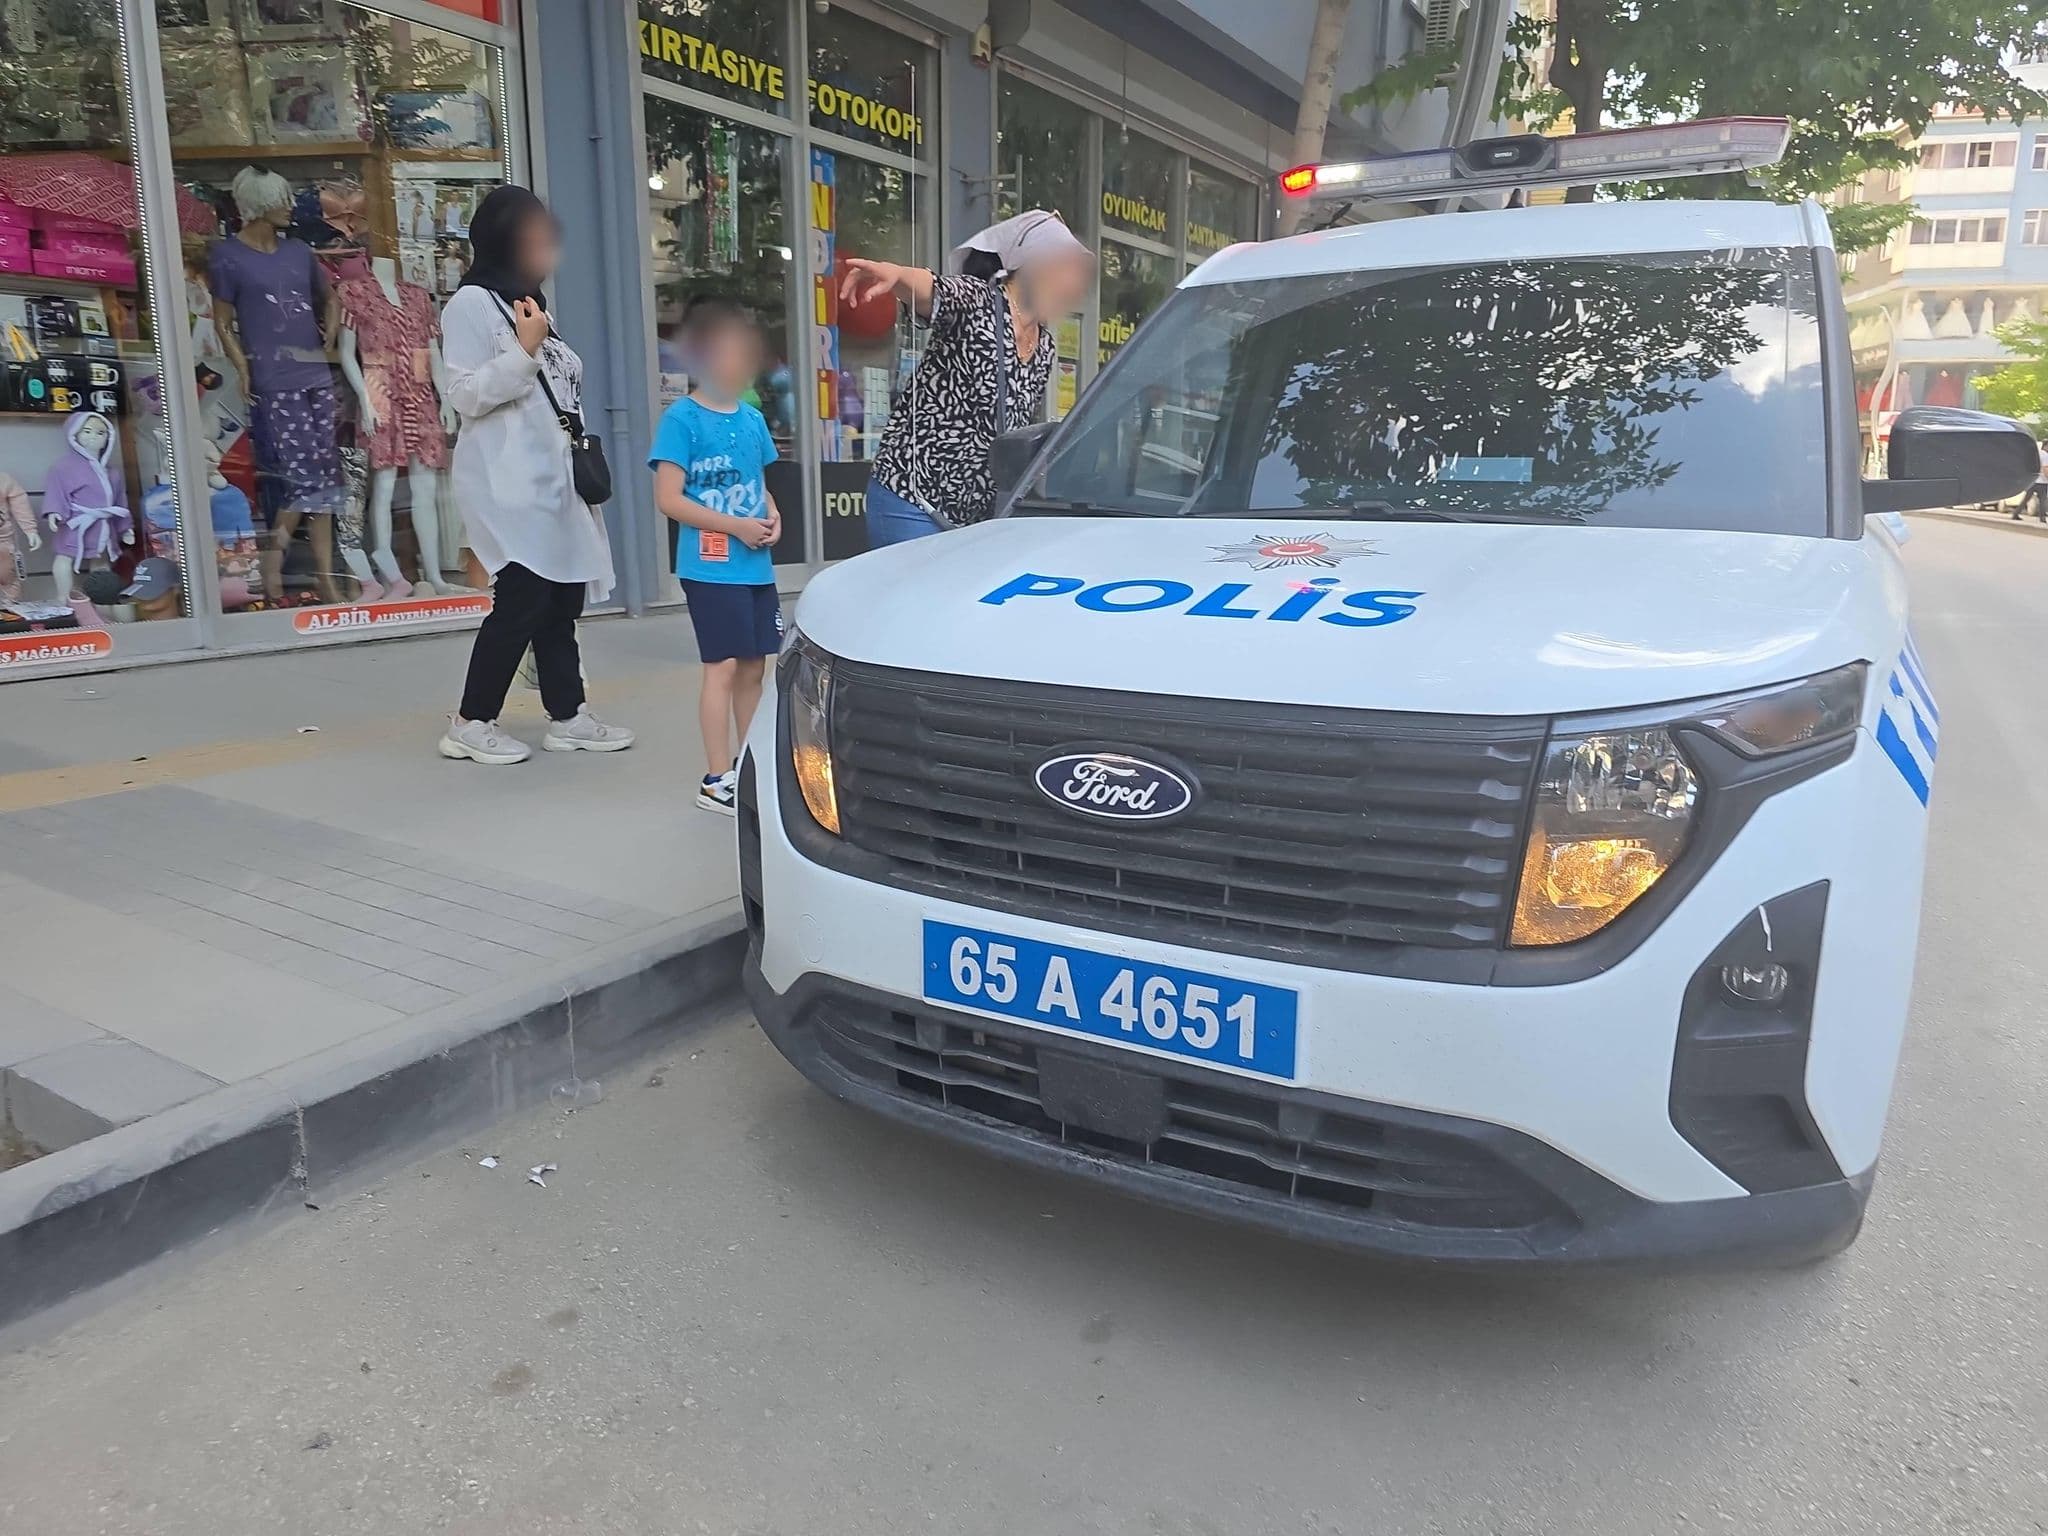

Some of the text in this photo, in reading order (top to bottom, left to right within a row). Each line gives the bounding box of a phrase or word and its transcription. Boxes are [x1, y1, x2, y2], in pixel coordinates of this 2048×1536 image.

[1102, 191, 1167, 233] OYUNCAK
[691, 454, 733, 473] WORK
[308, 607, 371, 630] AL-BİR
[14, 643, 97, 663] MAĞAZASI
[1062, 761, 1160, 812] Ford
[949, 936, 1257, 1060] 65 A 4651
